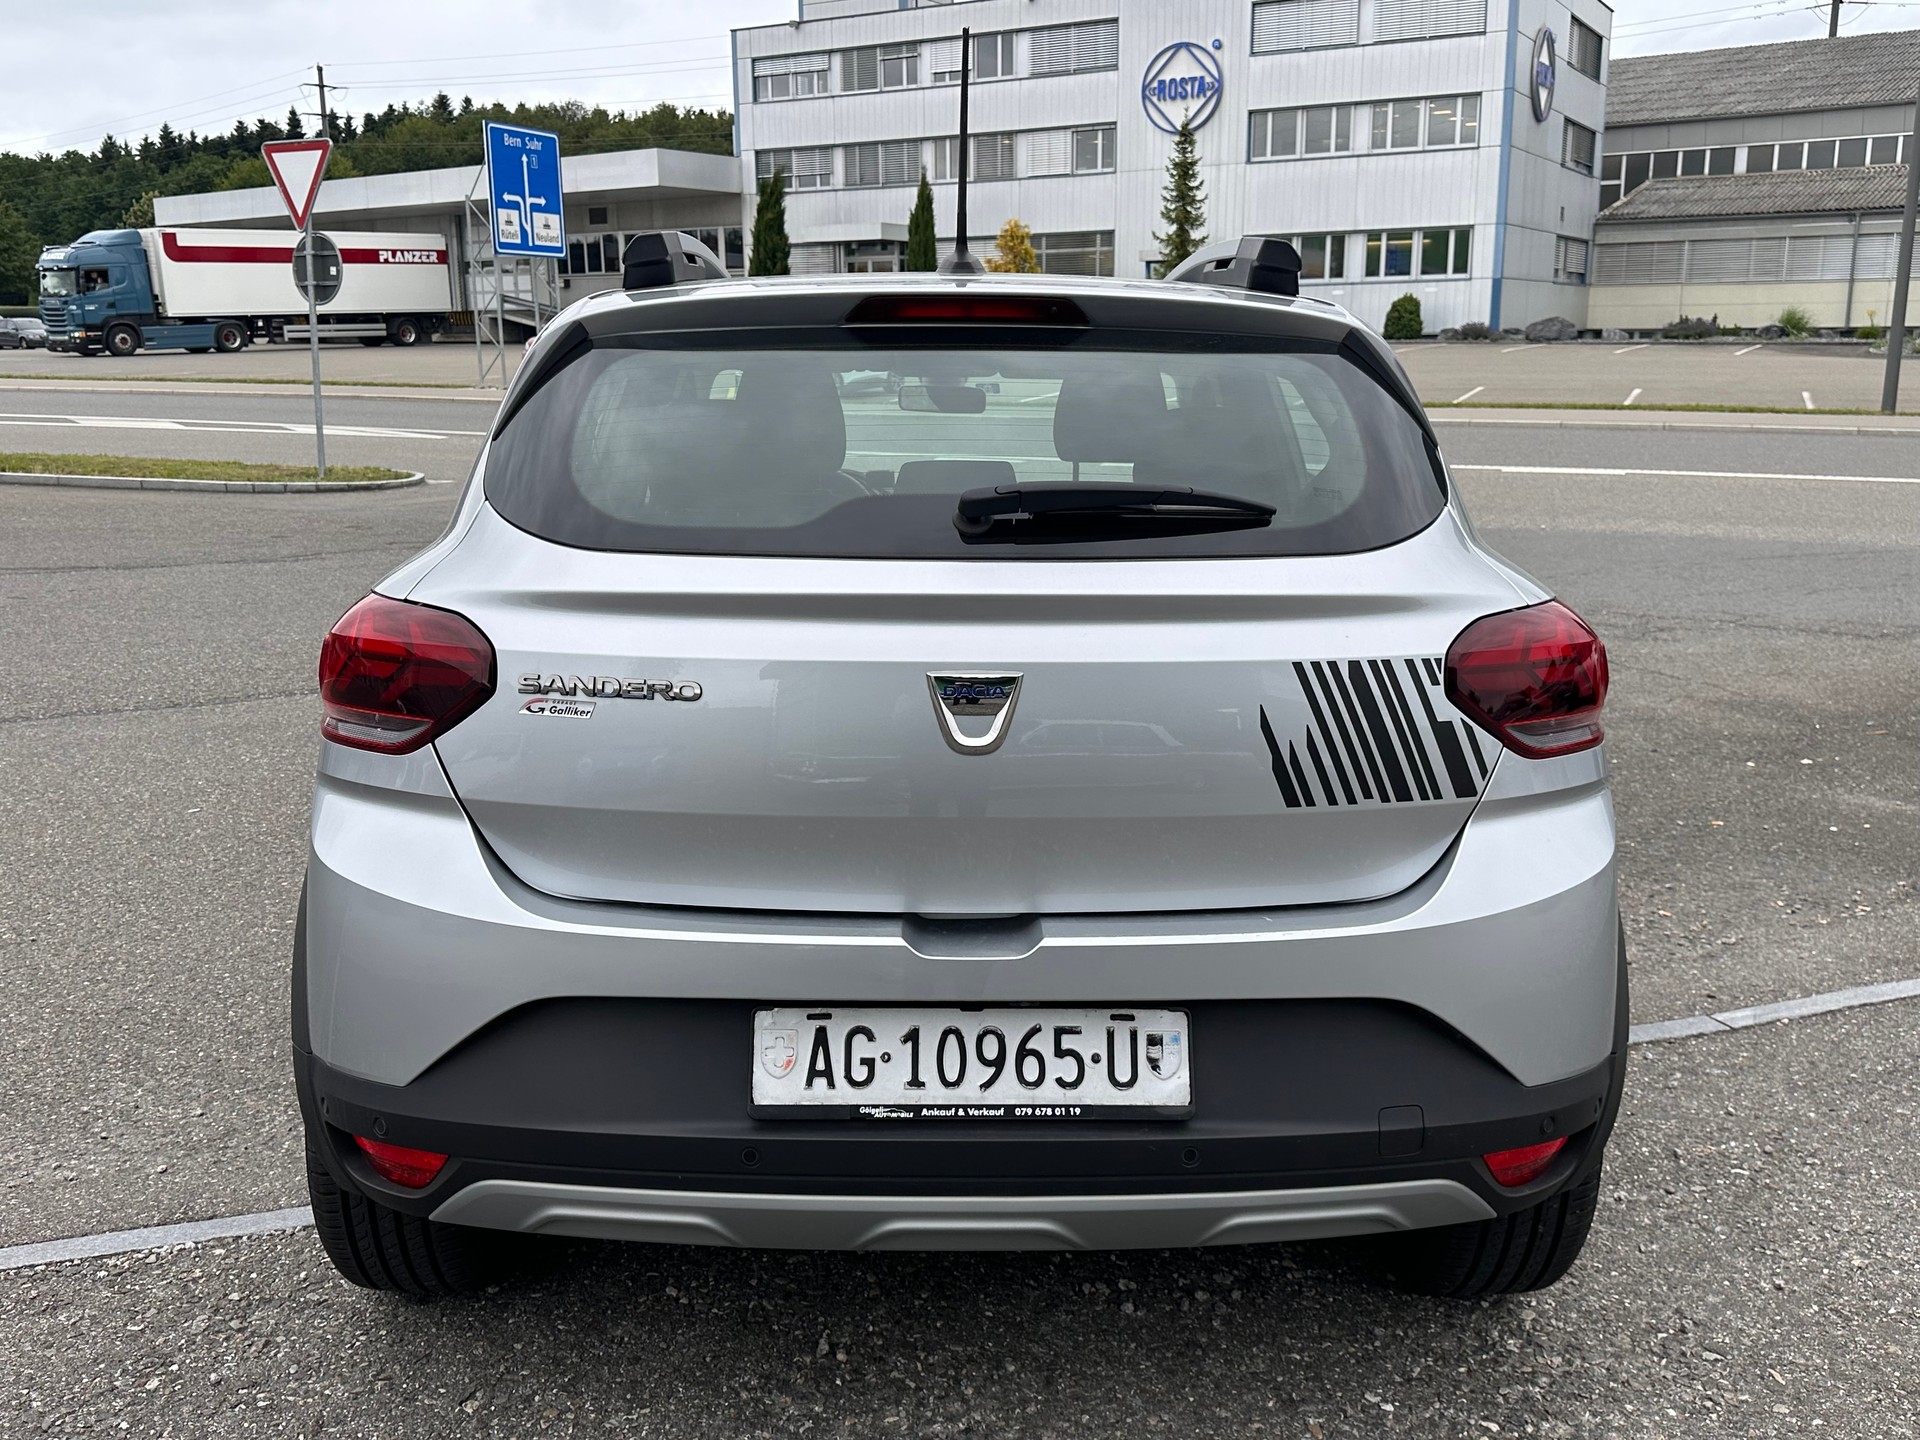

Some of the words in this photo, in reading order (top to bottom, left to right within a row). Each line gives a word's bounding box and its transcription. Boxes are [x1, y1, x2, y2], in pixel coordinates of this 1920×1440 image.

[503, 133, 522, 148] Bern
[525, 137, 543, 151] Suhr
[536, 232, 560, 244] Neuland
[378, 250, 439, 263] PLANZER
[518, 672, 703, 702] SANDERO
[943, 685, 1005, 698] DACIA
[549, 705, 591, 717] Galliker
[921, 1107, 955, 1116] Ankauf
[957, 1108, 965, 1116] &
[967, 1107, 1005, 1116] Verkauf
[1014, 1107, 1033, 1116] 079
[1034, 1107, 1053, 1116] 678
[1054, 1107, 1066, 1116] 01
[1069, 1107, 1081, 1116] 19
